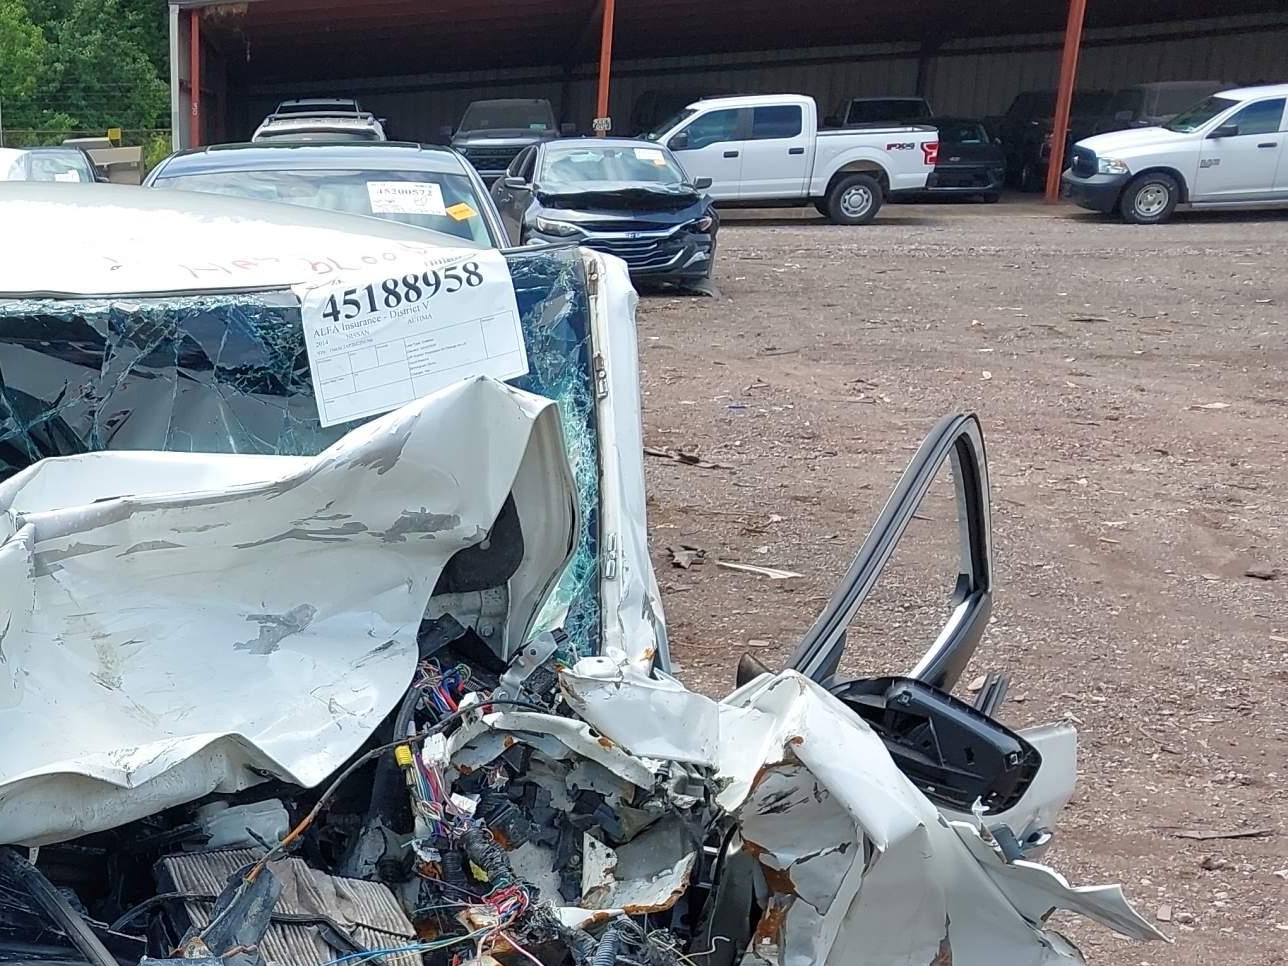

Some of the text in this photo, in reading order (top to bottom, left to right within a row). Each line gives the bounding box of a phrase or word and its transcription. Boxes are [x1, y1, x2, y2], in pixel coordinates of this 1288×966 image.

[322, 261, 484, 322] 45188958
[313, 325, 340, 338] ALFA
[342, 316, 381, 332] Insurance
[389, 304, 420, 319] District
[423, 301, 430, 311] V
